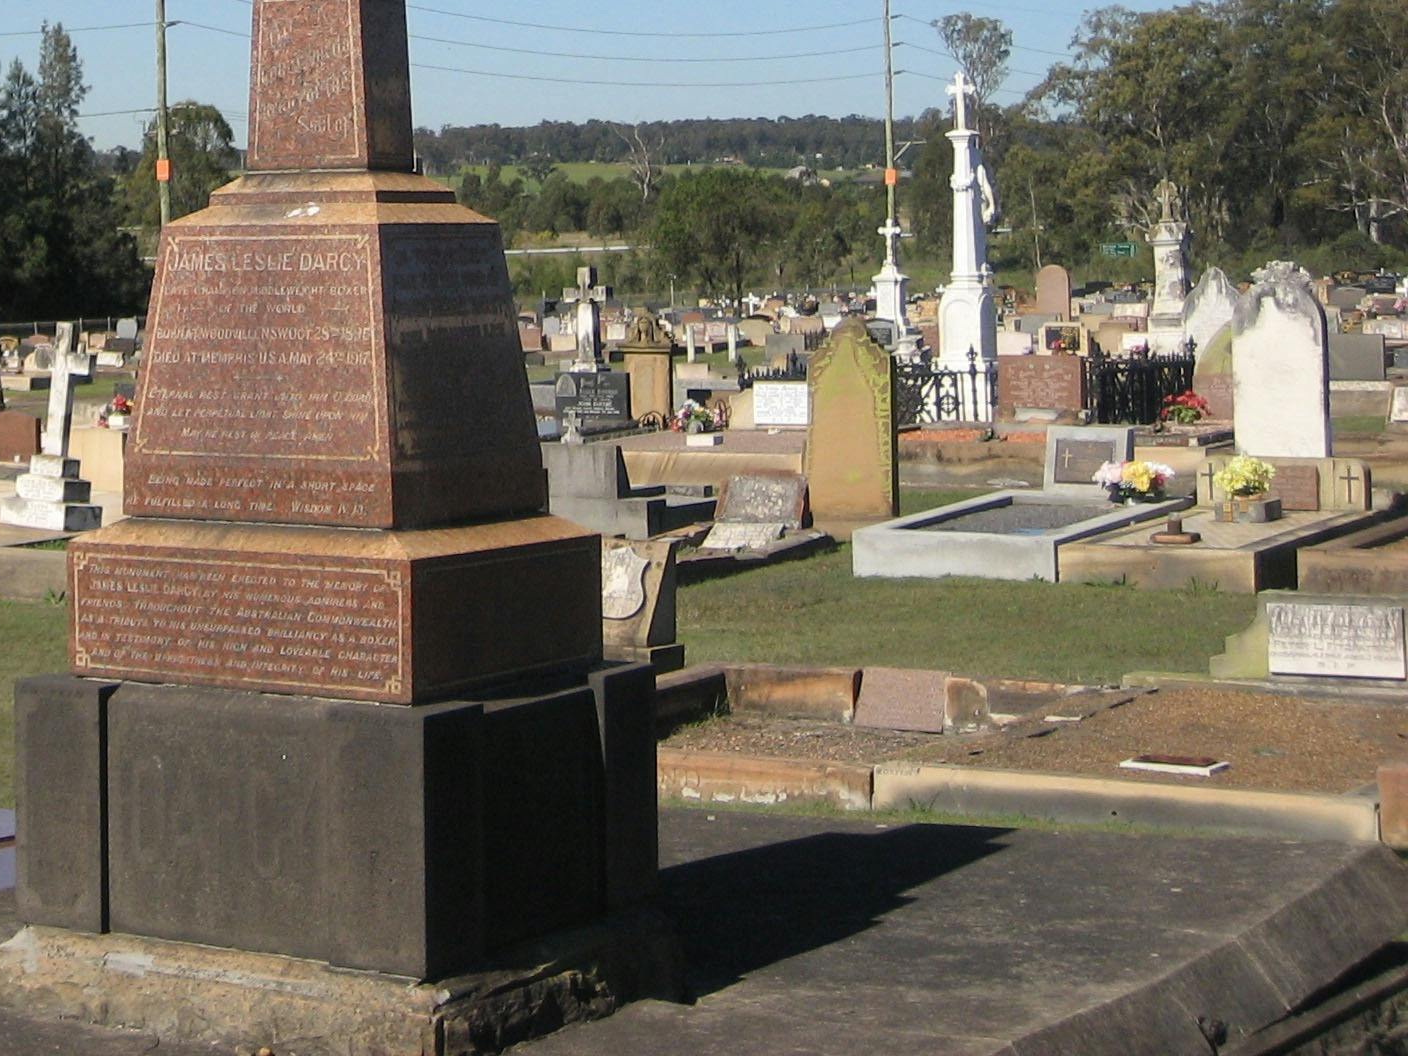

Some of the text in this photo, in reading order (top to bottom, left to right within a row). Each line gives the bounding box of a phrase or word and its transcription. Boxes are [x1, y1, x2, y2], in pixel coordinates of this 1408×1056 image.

[168, 252, 364, 272] JAMES LESLIE DARCY
[219, 303, 305, 314] OF THE WORLD
[153, 351, 180, 364] DIED
[184, 351, 197, 364] AT
[200, 352, 254, 364] MEMPHIS
[289, 352, 313, 365] MAY
[146, 407, 168, 417] AND
[172, 408, 191, 417] LET
[148, 474, 180, 486] BEING
[185, 476, 212, 487] MADE
[219, 477, 264, 488] PERFECT
[300, 481, 336, 492] SHORT
[342, 481, 376, 492] SPACE
[144, 497, 195, 507] FULFILLED
[214, 500, 241, 509] LONG
[292, 501, 332, 513] WISDOM
[89, 564, 110, 575] THIS
[114, 567, 168, 578] MONUMENT
[232, 574, 277, 584] ERECTED
[283, 578, 296, 587] TO
[301, 578, 320, 588] THE
[325, 580, 368, 592] MEMORY
[90, 580, 123, 591] JAMES
[223, 591, 240, 600] HIS
[245, 592, 302, 604] NUMEROUS
[306, 596, 358, 608] ADMIRERS
[363, 599, 385, 610] AND
[80, 598, 397, 628] FRIENDS THROUGHOUT THE AUSTRALIAN COMMONWEALTH
[80, 614, 97, 624] AS
[98, 616, 105, 624] A
[108, 616, 148, 628] TRIBUTE
[153, 619, 166, 628] TO
[168, 620, 186, 631] HIS
[190, 621, 262, 635] UNSURPASSED
[267, 628, 327, 641] BRILLIANCY
[331, 632, 345, 643] AS
[348, 634, 356, 643] A
[79, 631, 98, 642] AND
[115, 632, 171, 646] TESTIMONY
[197, 639, 216, 650] HIS
[253, 644, 274, 654] AND
[337, 650, 399, 664] CHARACTER
[91, 647, 111, 658] AND
[113, 648, 127, 659] OF
[130, 650, 149, 661] THE
[251, 661, 304, 674] INTEGRITY
[312, 666, 326, 675] OF
[330, 666, 348, 678] HIS
